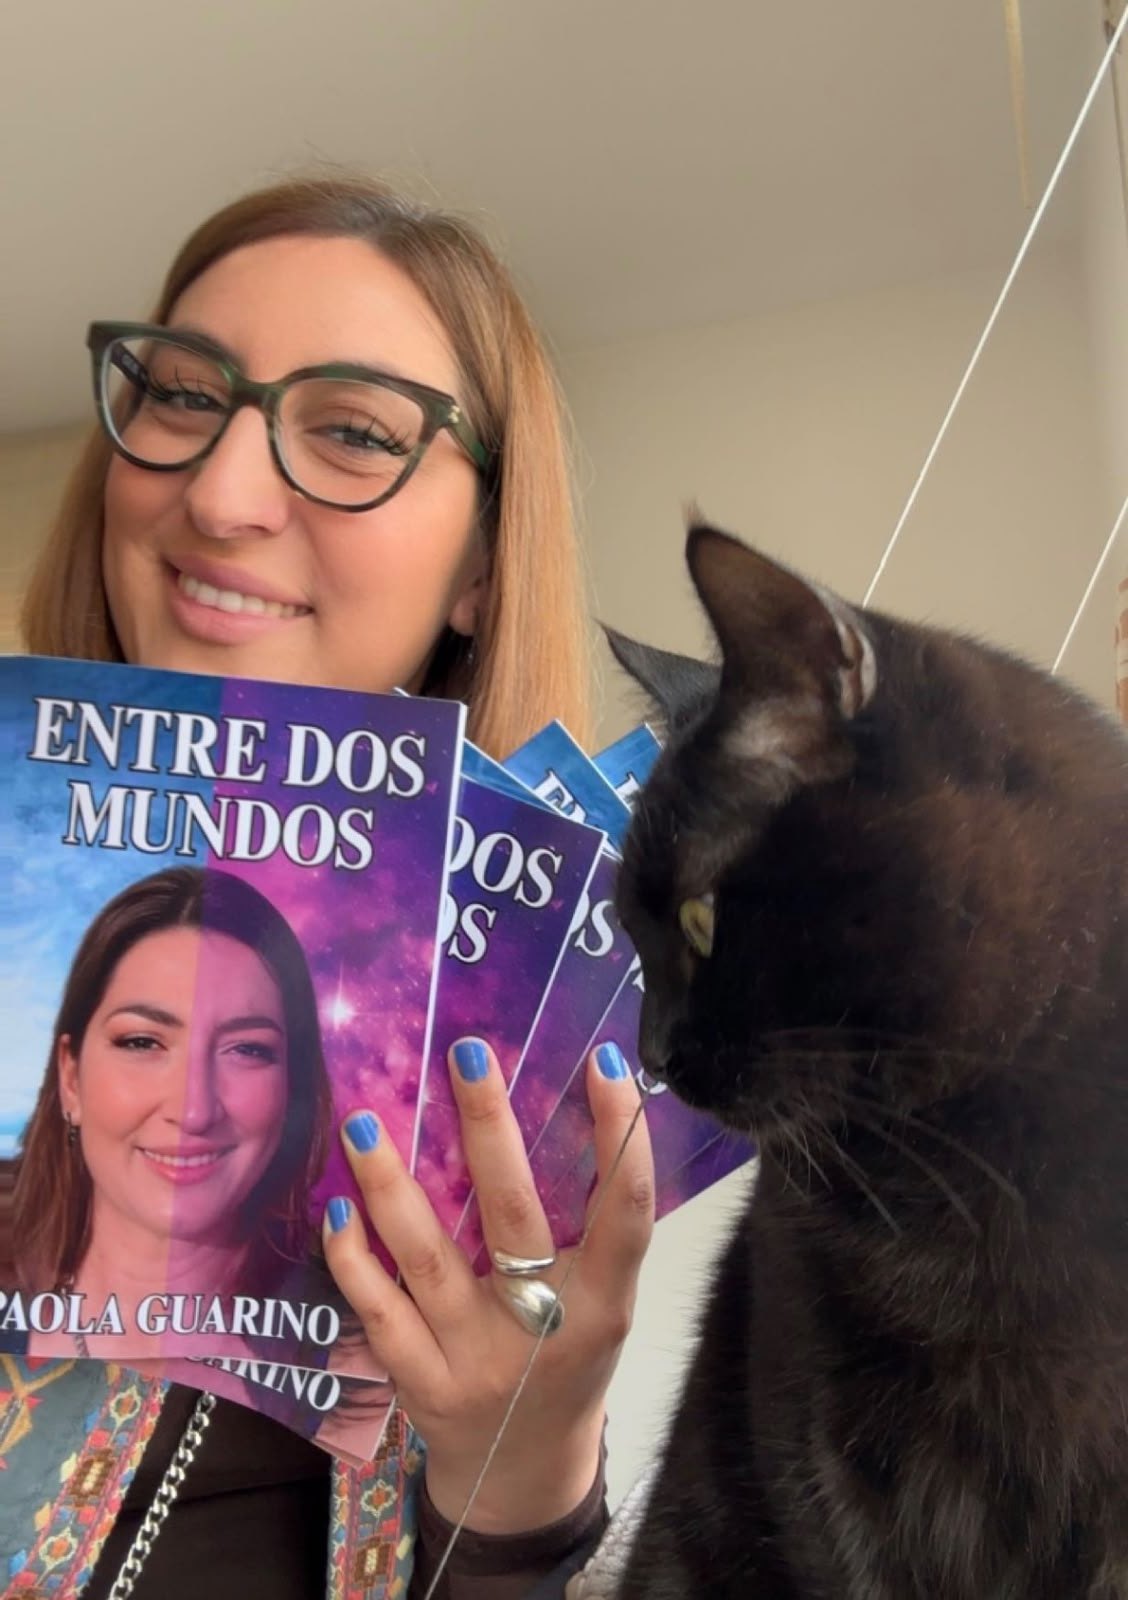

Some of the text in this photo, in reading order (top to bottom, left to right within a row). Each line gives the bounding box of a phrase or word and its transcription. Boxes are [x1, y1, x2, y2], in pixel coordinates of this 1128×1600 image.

[29, 697, 426, 797] ENTRE DOS
[62, 780, 375, 870] MUNDOS
[0, 1290, 341, 1346] AOLA GUARINO
